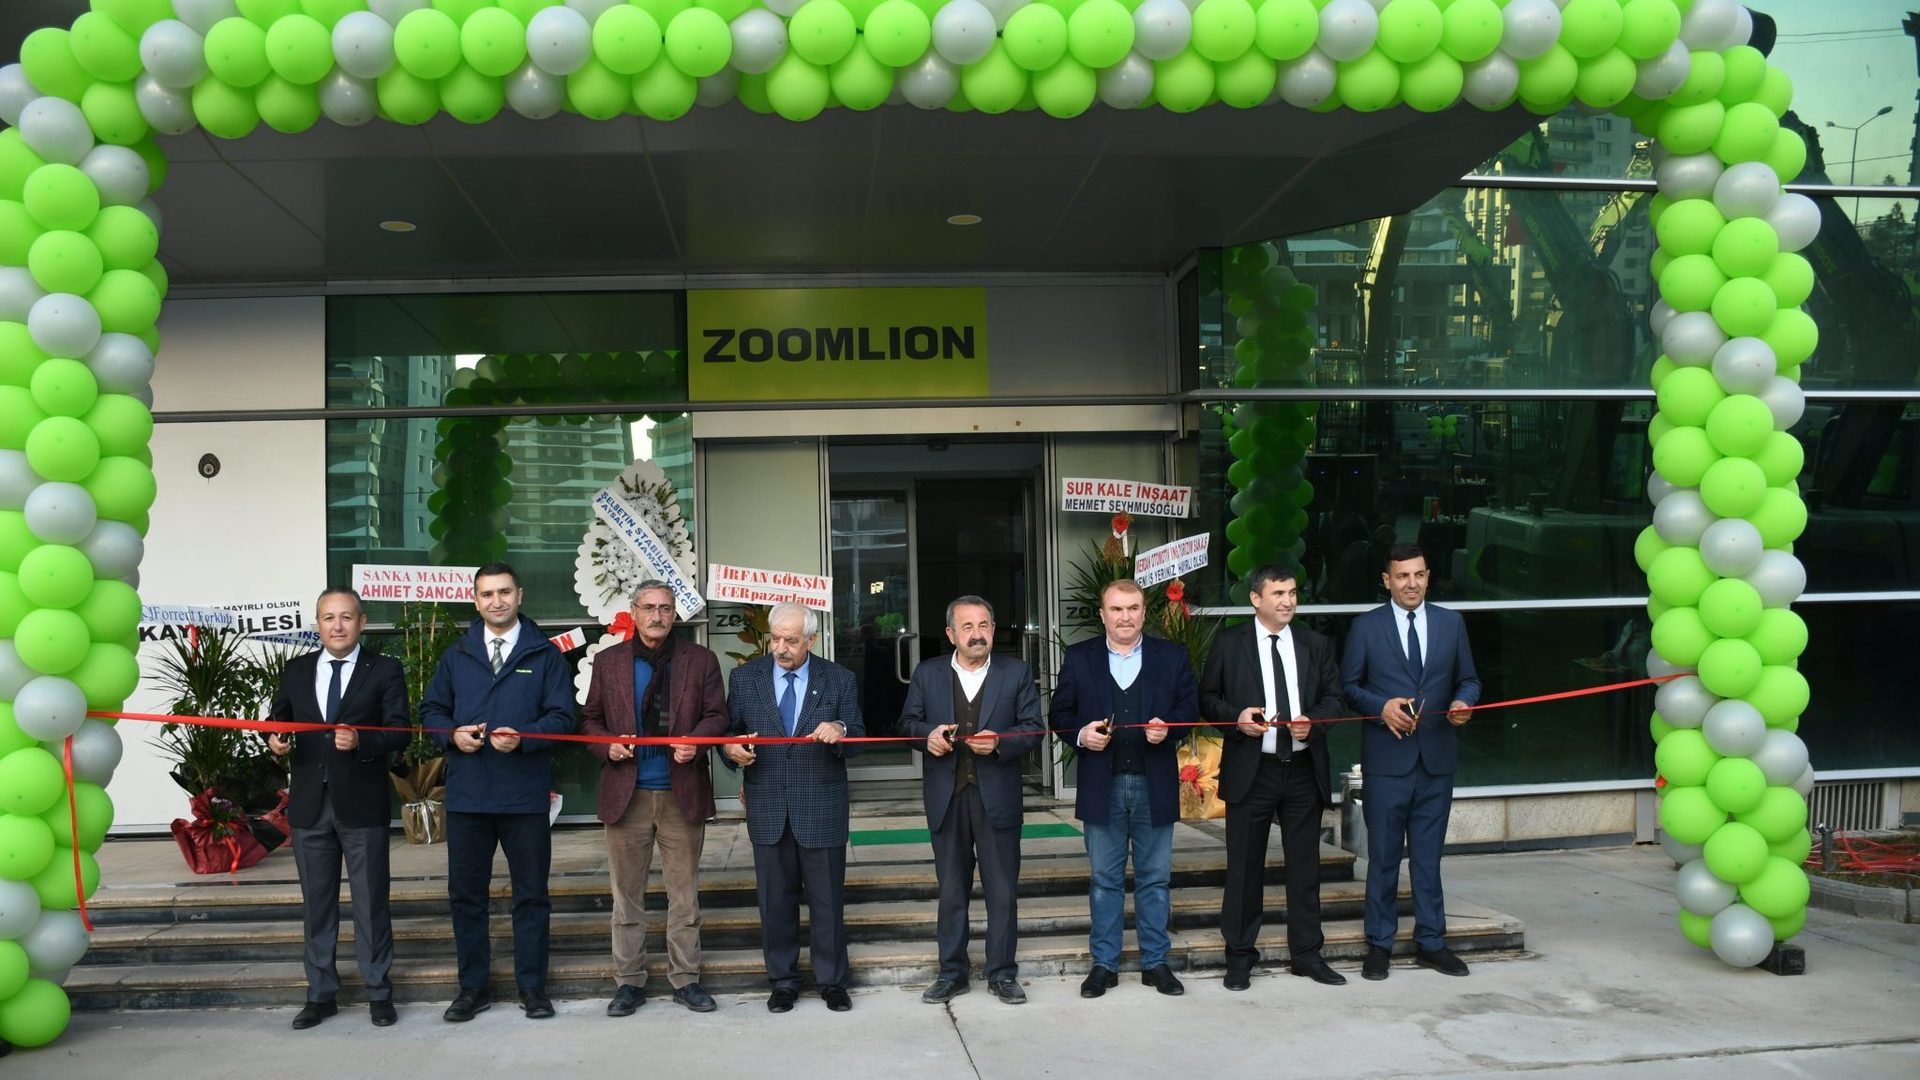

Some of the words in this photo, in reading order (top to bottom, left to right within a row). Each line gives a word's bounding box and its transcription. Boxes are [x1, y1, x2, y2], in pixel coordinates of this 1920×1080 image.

[703, 326, 975, 362] ZOOMLION
[1066, 481, 1093, 496] SUR
[1098, 483, 1132, 498] KALE
[1135, 484, 1188, 503] İNŞAAT
[1065, 498, 1105, 511] MEHMET
[596, 497, 624, 528] FAYSAL
[625, 529, 634, 537] &
[634, 538, 665, 577] HAMZA
[363, 569, 411, 582] SANKA
[416, 569, 474, 583] MAKİNA
[634, 527, 677, 578] STABİLİZE
[674, 578, 700, 608] OCAĞI
[722, 565, 769, 583] İRFAN
[772, 572, 828, 591] GÖKŞİN
[361, 584, 412, 598] AHMET
[415, 585, 476, 600] SANCAK
[266, 600, 300, 610] OLSUN
